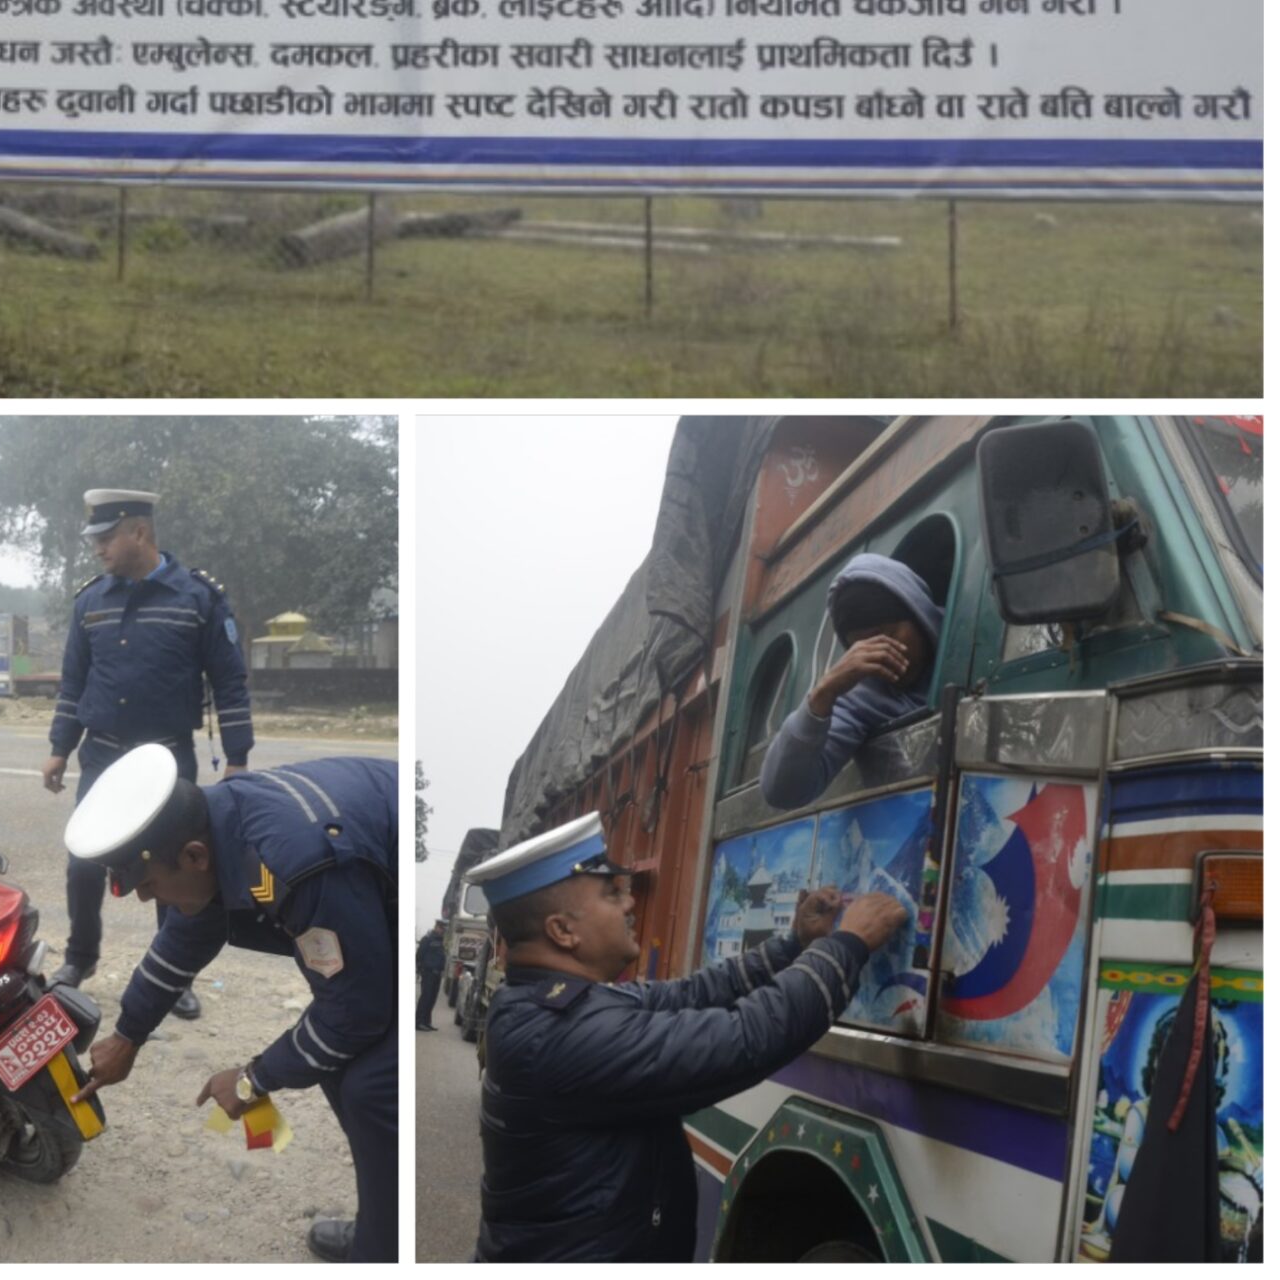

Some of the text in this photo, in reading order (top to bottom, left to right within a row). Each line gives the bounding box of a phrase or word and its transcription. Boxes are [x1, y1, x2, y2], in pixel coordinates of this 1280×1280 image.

[392, 37, 498, 70] प्रहरीका
[510, 38, 594, 70] सवारी
[604, 38, 744, 71] साधनलाई
[757, 37, 911, 72] प्राथमिकता
[146, 86, 198, 114] गर्दा
[210, 85, 332, 118] पछाडीको
[344, 89, 434, 119] भागमा
[445, 90, 515, 120] स्पष्ट
[527, 86, 611, 120] देखिने
[623, 88, 677, 120] गरी
[689, 87, 747, 120] रातो
[760, 91, 844, 120] कपडा
[936, 91, 965, 119] वा
[977, 87, 1029, 120] राते
[1105, 86, 1182, 120] बाल्ने
